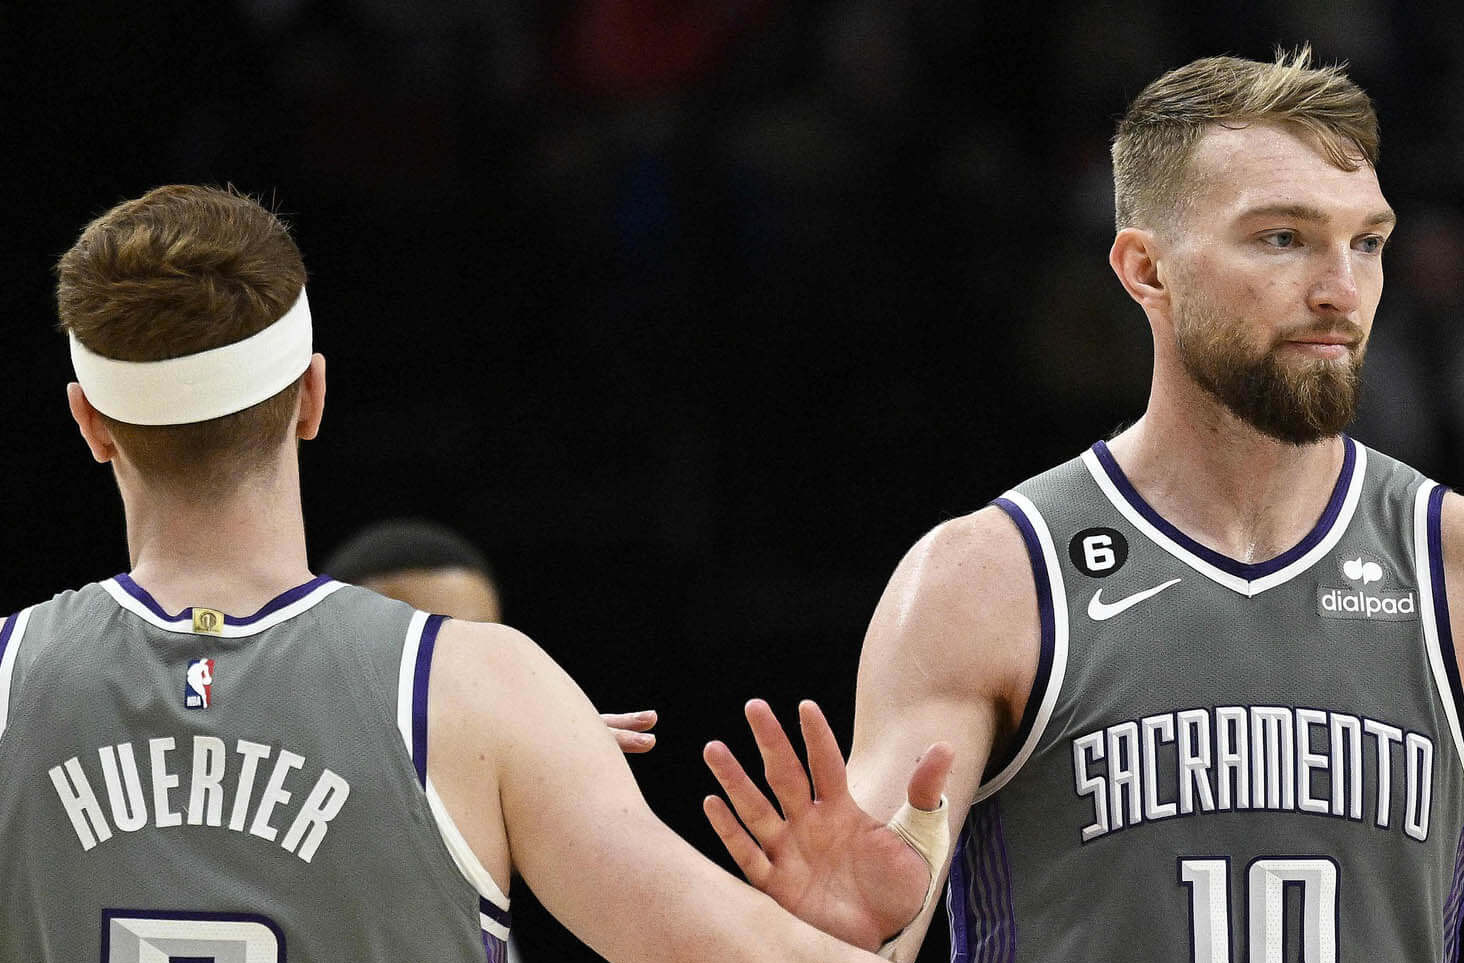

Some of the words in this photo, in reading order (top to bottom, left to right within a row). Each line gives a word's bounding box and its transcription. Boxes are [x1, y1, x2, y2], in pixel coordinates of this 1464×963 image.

[1082, 534, 1116, 571] 6
[1321, 589, 1415, 618] dialpad
[48, 735, 350, 864] HUERTER
[1071, 704, 1435, 844] SACRAMENTO
